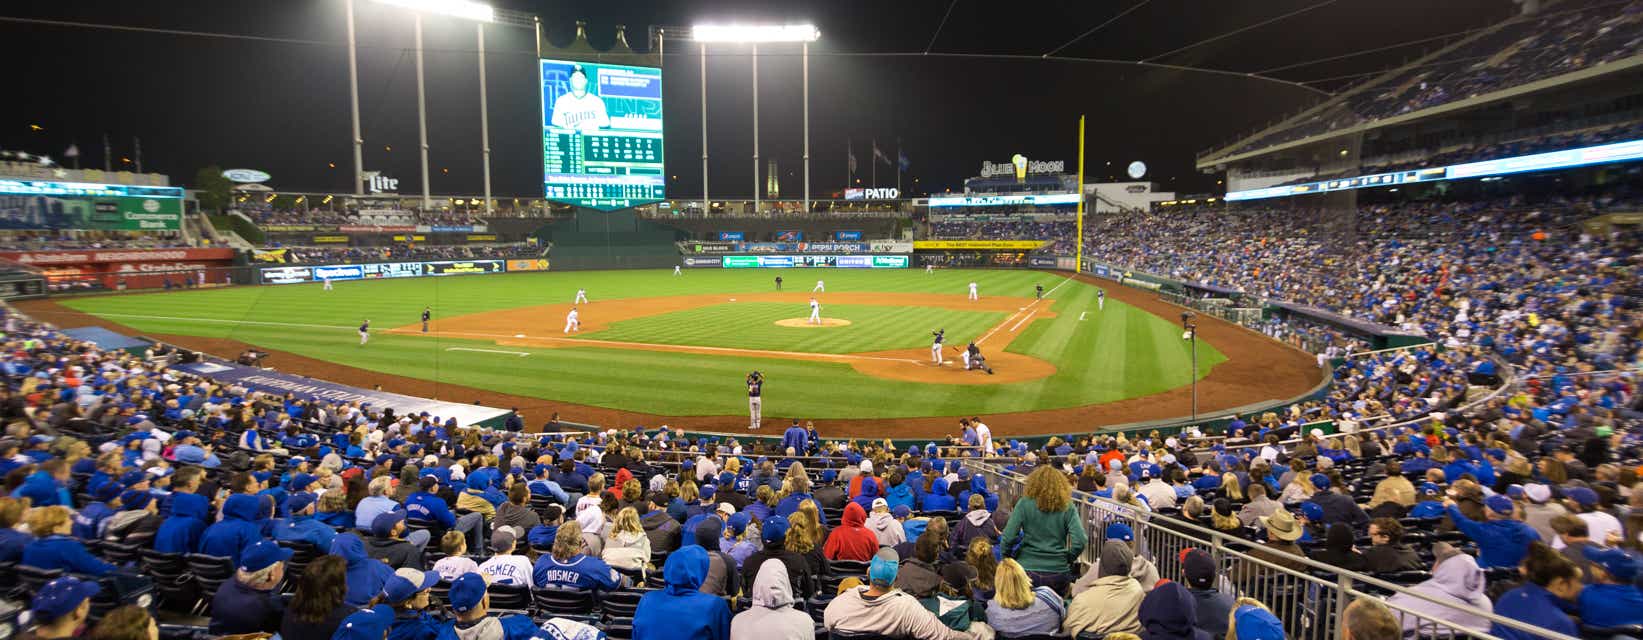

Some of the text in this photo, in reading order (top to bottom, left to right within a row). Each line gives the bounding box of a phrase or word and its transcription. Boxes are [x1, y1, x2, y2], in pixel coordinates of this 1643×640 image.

[1028, 160, 1065, 173] MOON
[370, 175, 399, 192] Lite
[865, 188, 898, 199] PATIO
[547, 570, 580, 583] HOSMER
